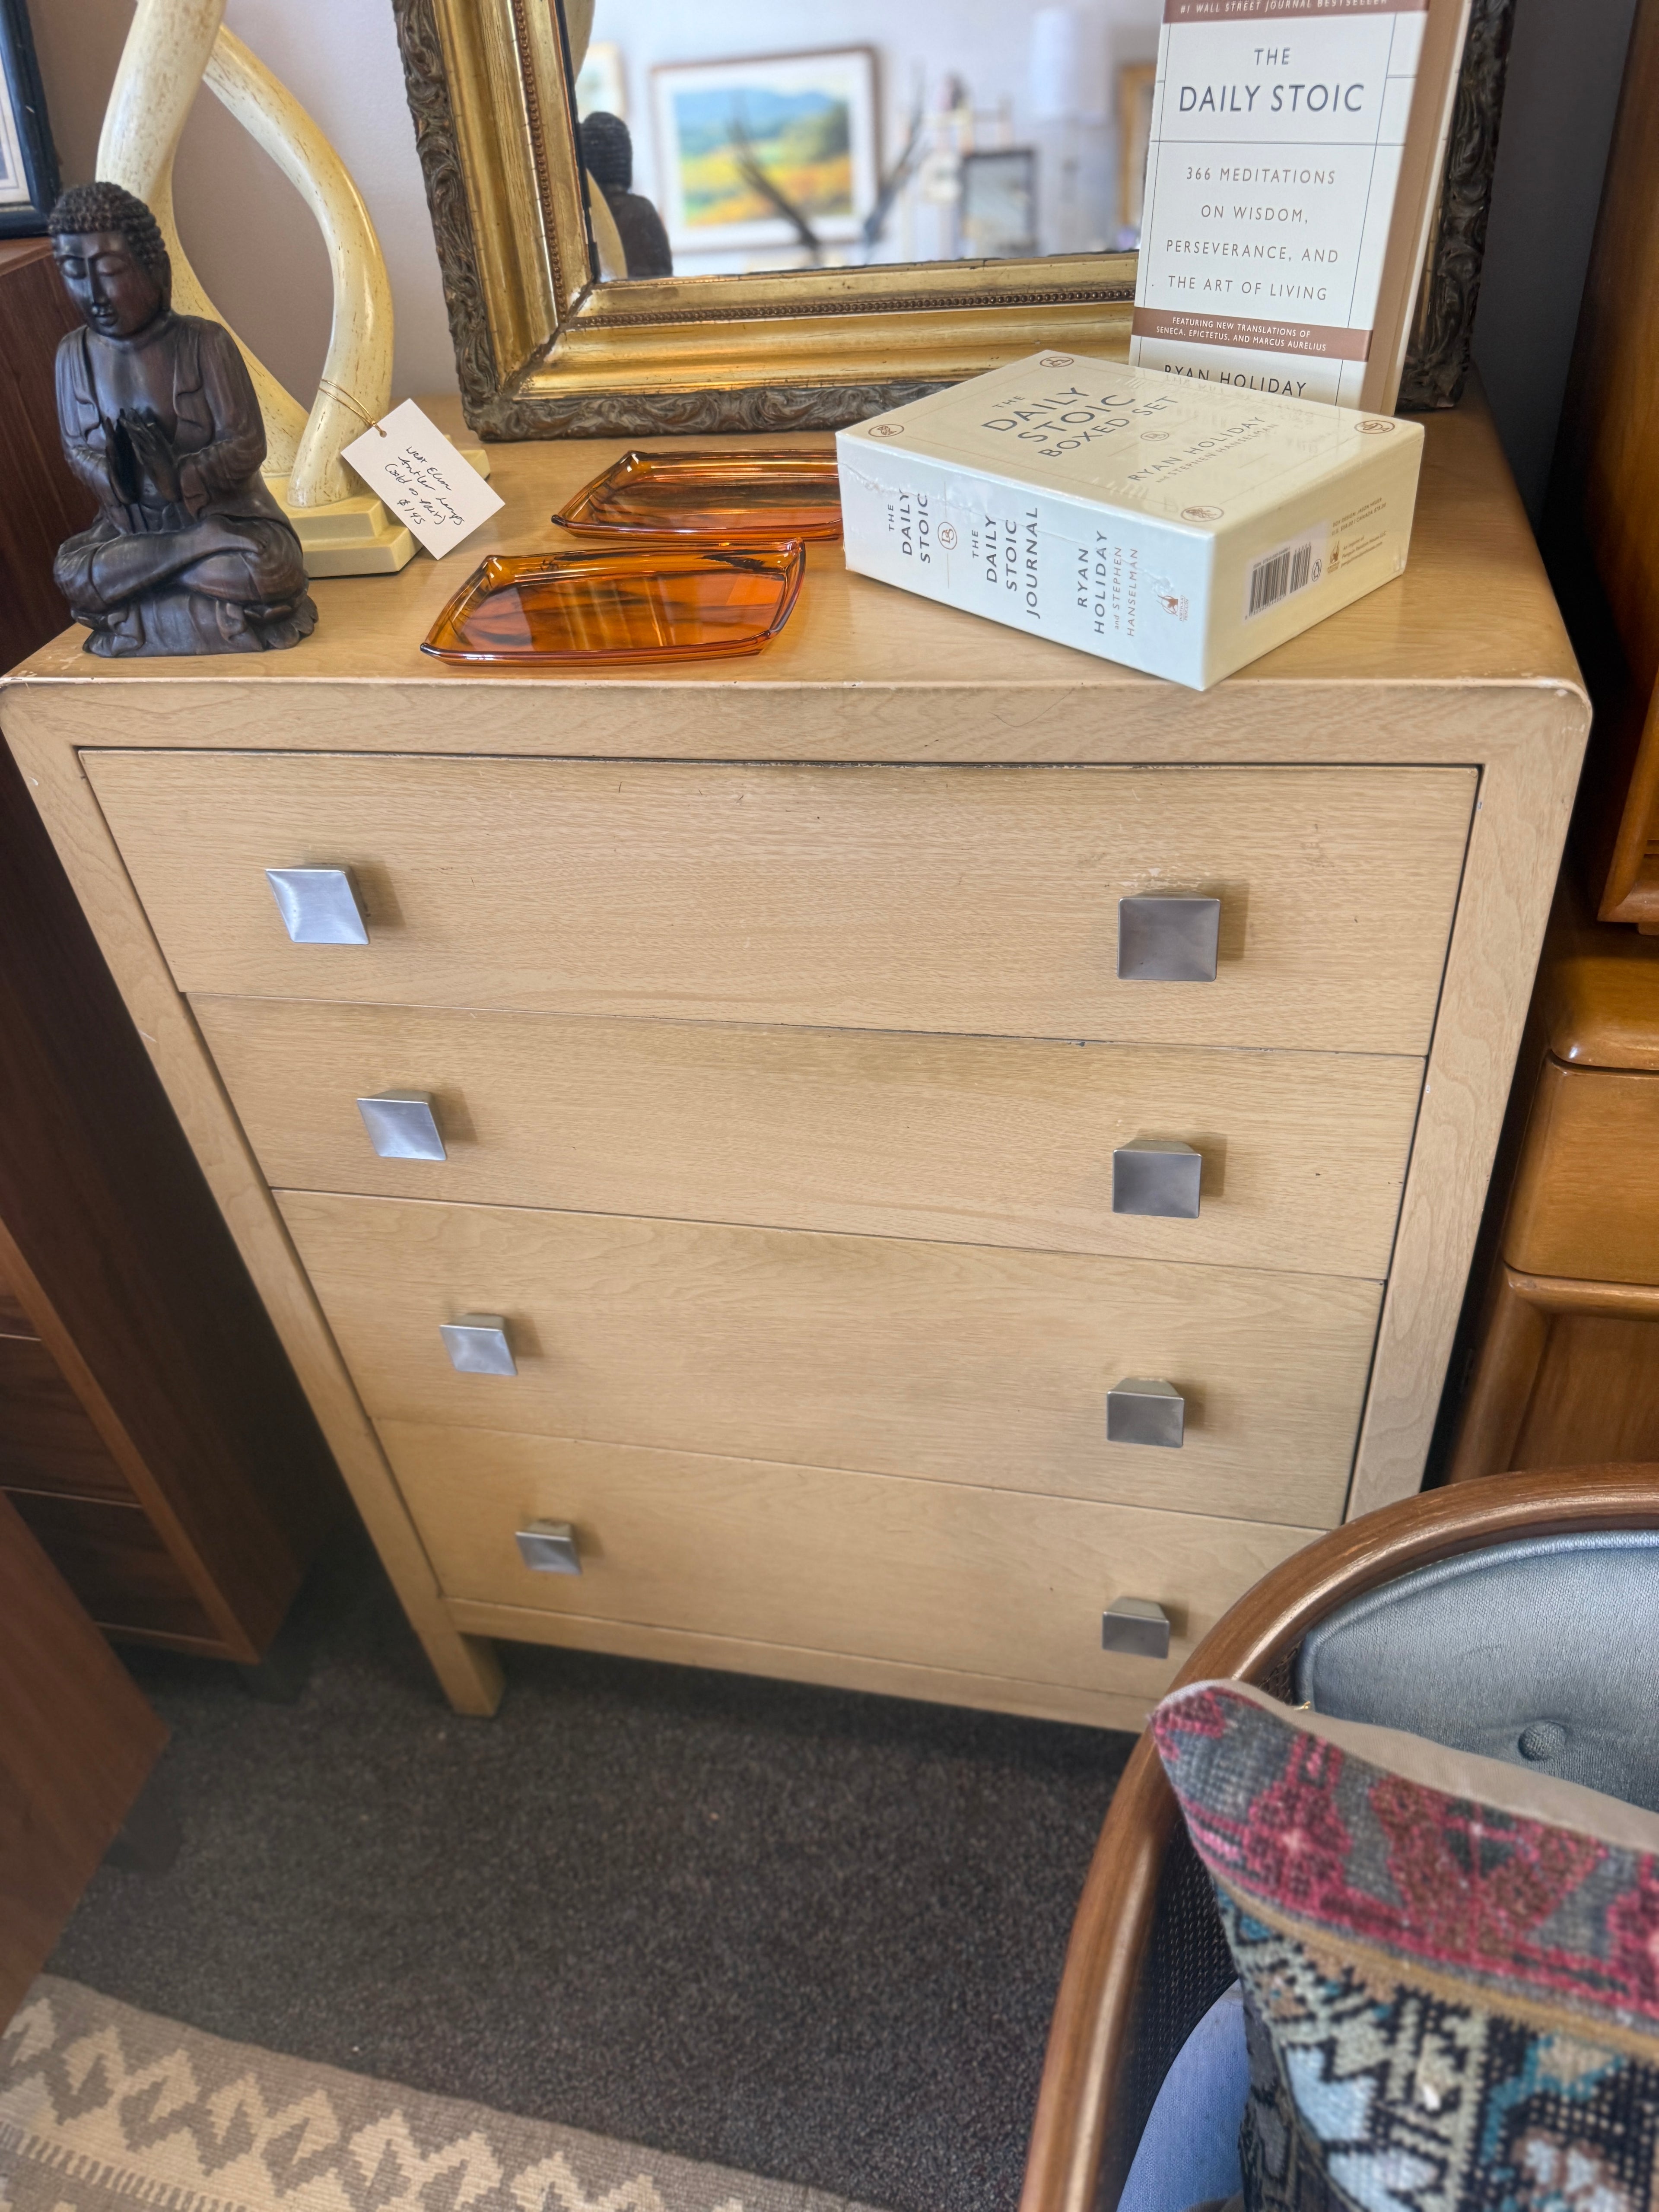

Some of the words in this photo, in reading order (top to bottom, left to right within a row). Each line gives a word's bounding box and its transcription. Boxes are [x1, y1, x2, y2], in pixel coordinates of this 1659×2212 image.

[1180, 5, 1190, 14] #1
[1196, 3, 1220, 13] WALL
[1225, 2, 1260, 12] STREET
[1265, 0, 1311, 12] JOURNAL
[1254, 48, 1291, 66] THE
[1179, 86, 1261, 112] DAILY
[1271, 85, 1364, 112] STOIC
[1186, 167, 1211, 181] 366
[1220, 168, 1335, 185] MEDITATIONS
[1201, 205, 1224, 218] ON
[1233, 206, 1309, 224] WISDOM,
[1166, 240, 1292, 262] PERSEVERANCE,
[1301, 248, 1338, 263] AND
[1168, 275, 1196, 289] THE
[1203, 279, 1233, 293] ART
[1242, 282, 1262, 294] OF
[1270, 284, 1327, 300] LIVING
[1172, 317, 1213, 328] FEATURING
[1217, 321, 1234, 330] NEW
[1237, 324, 1296, 337] TRANSLATIONS
[1253, 337, 1284, 347] MARCUS
[1287, 340, 1326, 351] AURELIUS
[992, 396, 1026, 408] THE
[1220, 372, 1306, 397] HOLIDAY
[981, 387, 1090, 431] DAILY
[1017, 394, 1136, 442] STOIC
[1037, 418, 1130, 457] BOXED
[1132, 396, 1178, 416] SET
[1128, 457, 1182, 481] RYAN
[1183, 417, 1265, 454] HOLIDAY
[1168, 453, 1216, 475] STEPHEN
[1216, 423, 1279, 453] HANSELMAN
[397, 499, 426, 524] $145
[899, 489, 912, 556] DAILY
[917, 493, 930, 563] STOIC
[985, 515, 997, 583] DAILY
[1005, 520, 1017, 591] STOIC
[1026, 508, 1040, 619] JOURNAL
[1077, 548, 1088, 608] RYAN
[1094, 530, 1107, 634] HOLIDAY
[1112, 547, 1122, 610] STEPHEN
[1127, 549, 1138, 637] HANSELMAN
